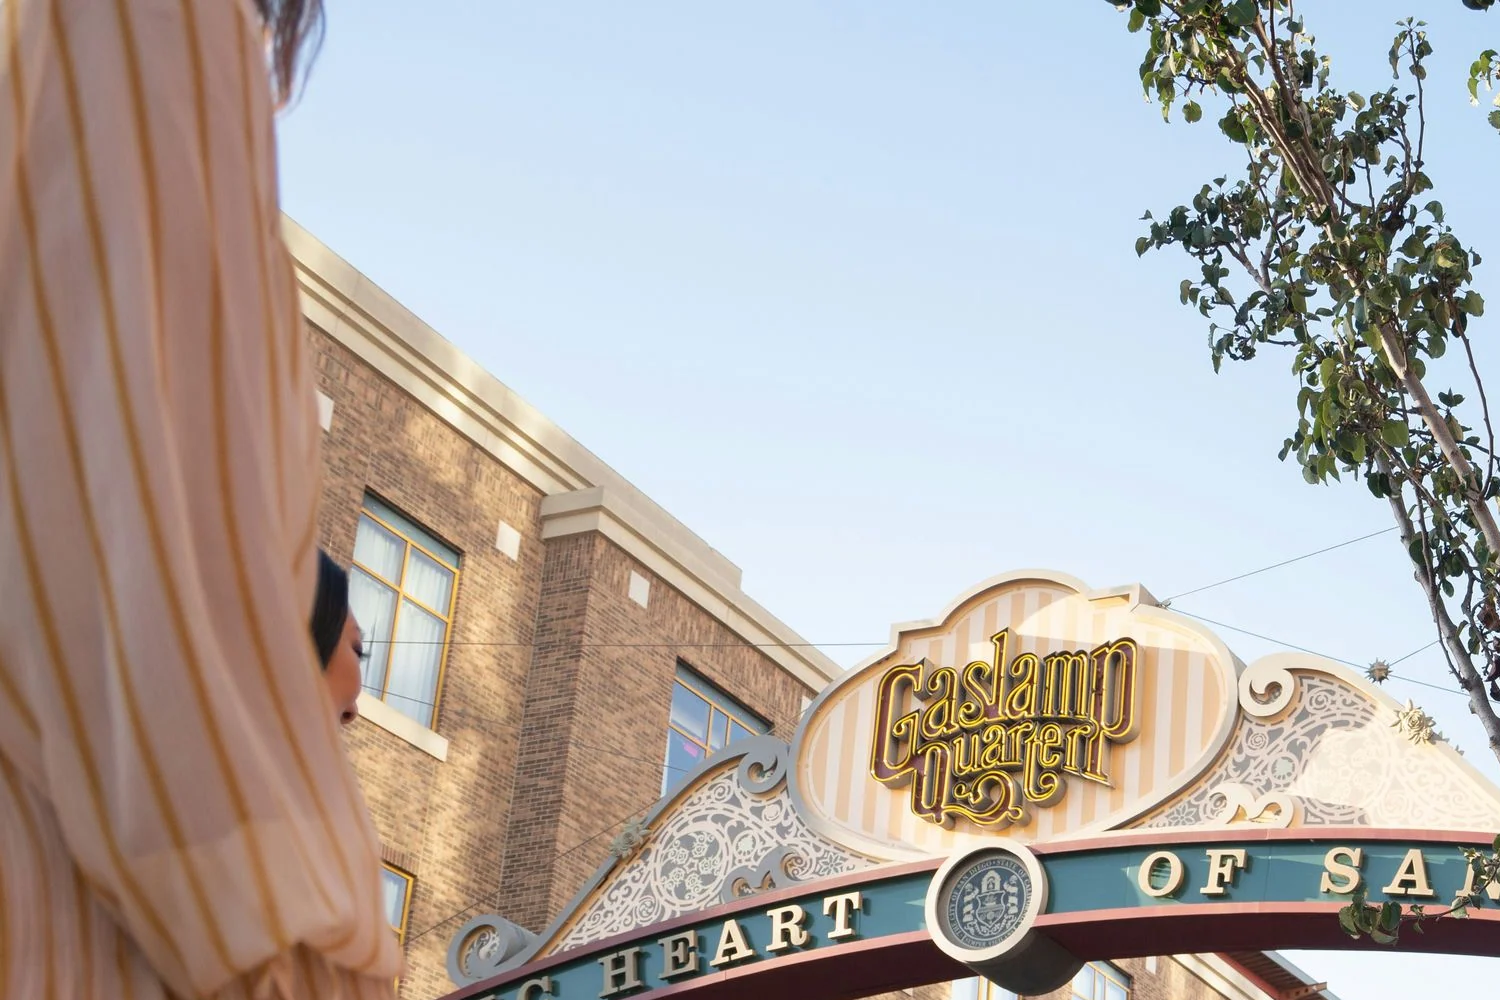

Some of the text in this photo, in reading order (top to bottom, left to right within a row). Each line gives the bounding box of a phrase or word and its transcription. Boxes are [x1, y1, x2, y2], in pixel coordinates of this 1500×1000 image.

[870, 627, 1141, 788] Gaslamp
[911, 718, 1115, 829] Quarter
[598, 891, 865, 998] HEART
[1138, 848, 1248, 898] OF
